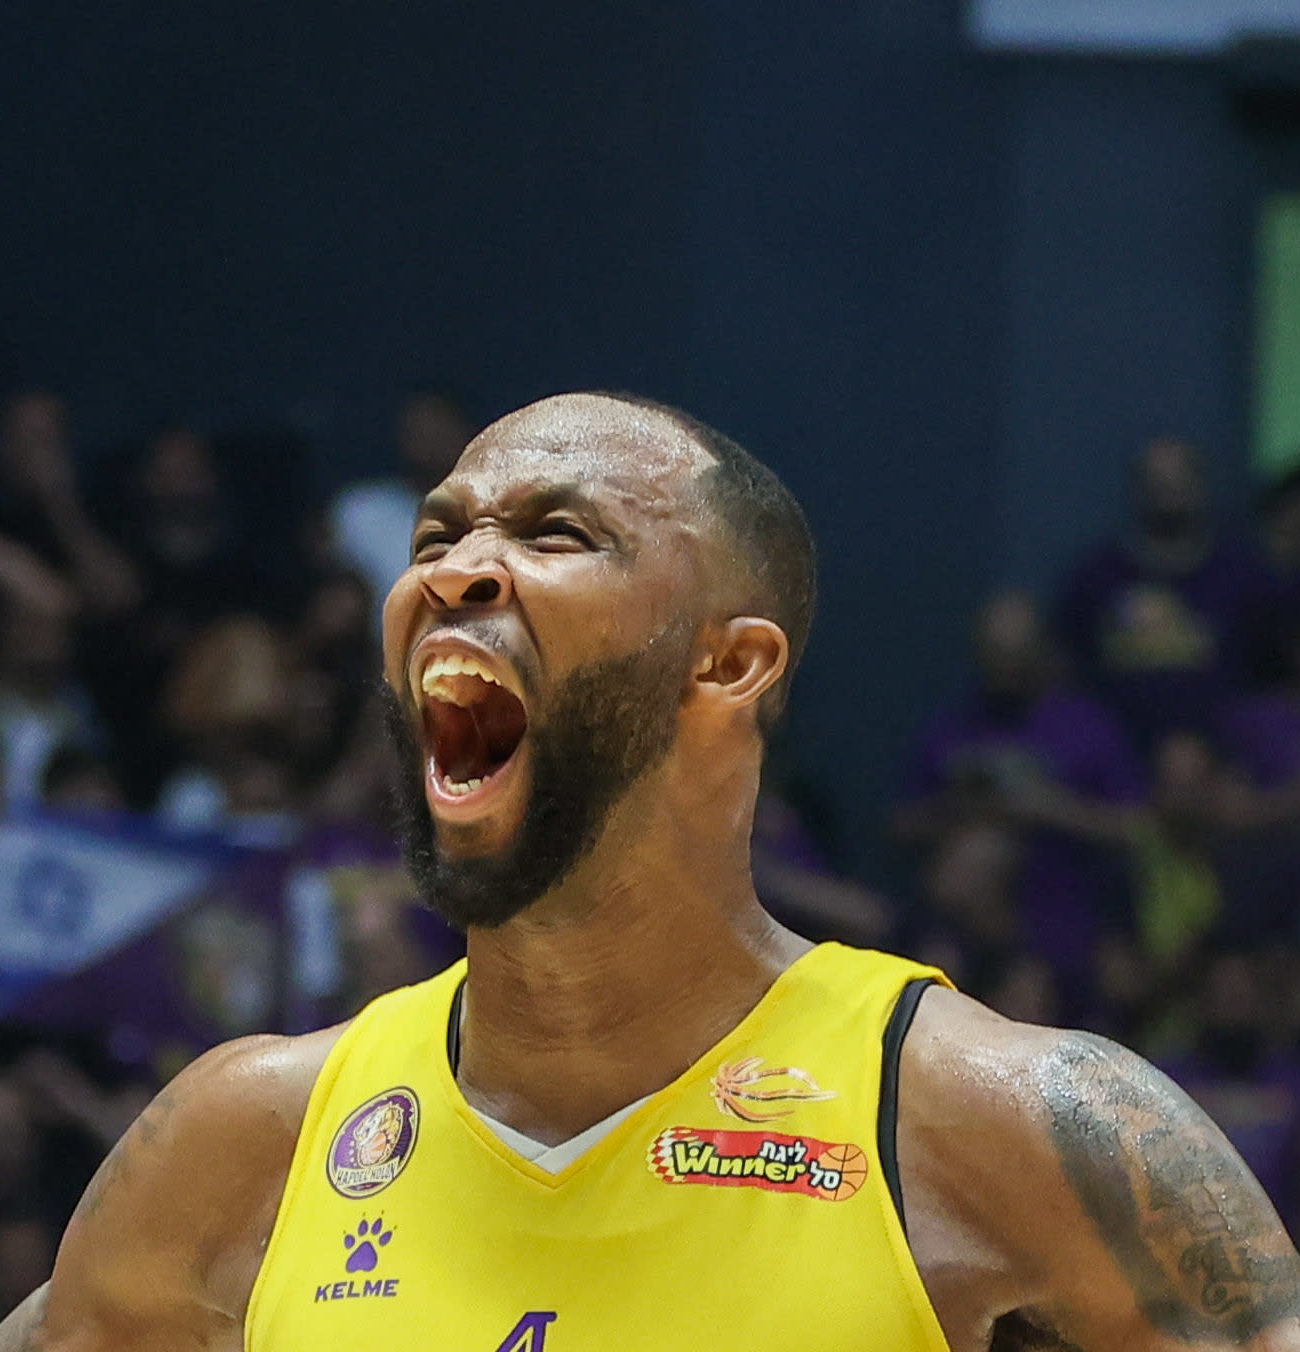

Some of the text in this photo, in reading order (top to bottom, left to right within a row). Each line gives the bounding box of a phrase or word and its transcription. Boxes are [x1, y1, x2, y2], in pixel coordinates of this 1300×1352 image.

[672, 1141, 807, 1183] Winner
[759, 1140, 806, 1164] ליגת
[809, 1160, 842, 1190] סל
[314, 1279, 399, 1303] KELME
